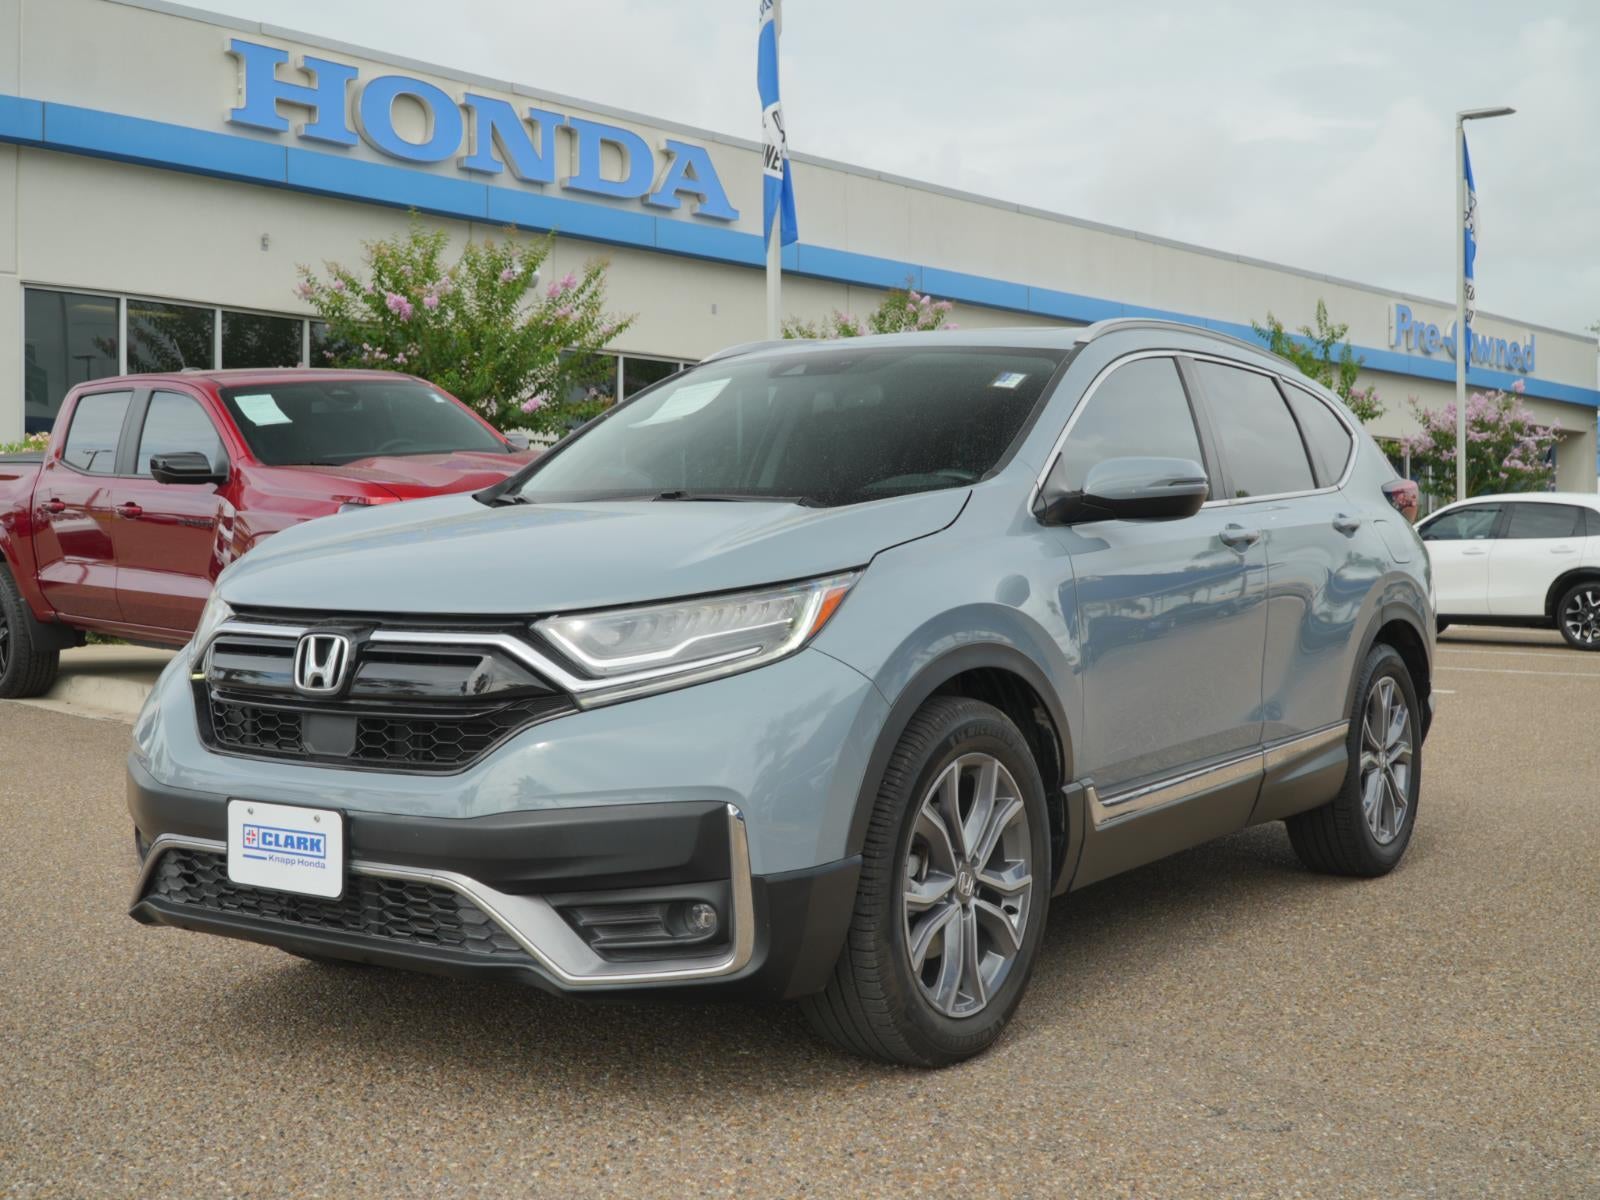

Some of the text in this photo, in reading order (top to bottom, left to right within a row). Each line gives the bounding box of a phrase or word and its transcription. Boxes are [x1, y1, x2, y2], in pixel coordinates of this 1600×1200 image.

[225, 38, 740, 221] HONDA
[1389, 303, 1535, 373] Pre-wned
[261, 831, 322, 853] CLARK
[268, 854, 326, 869] Knapp Honda
